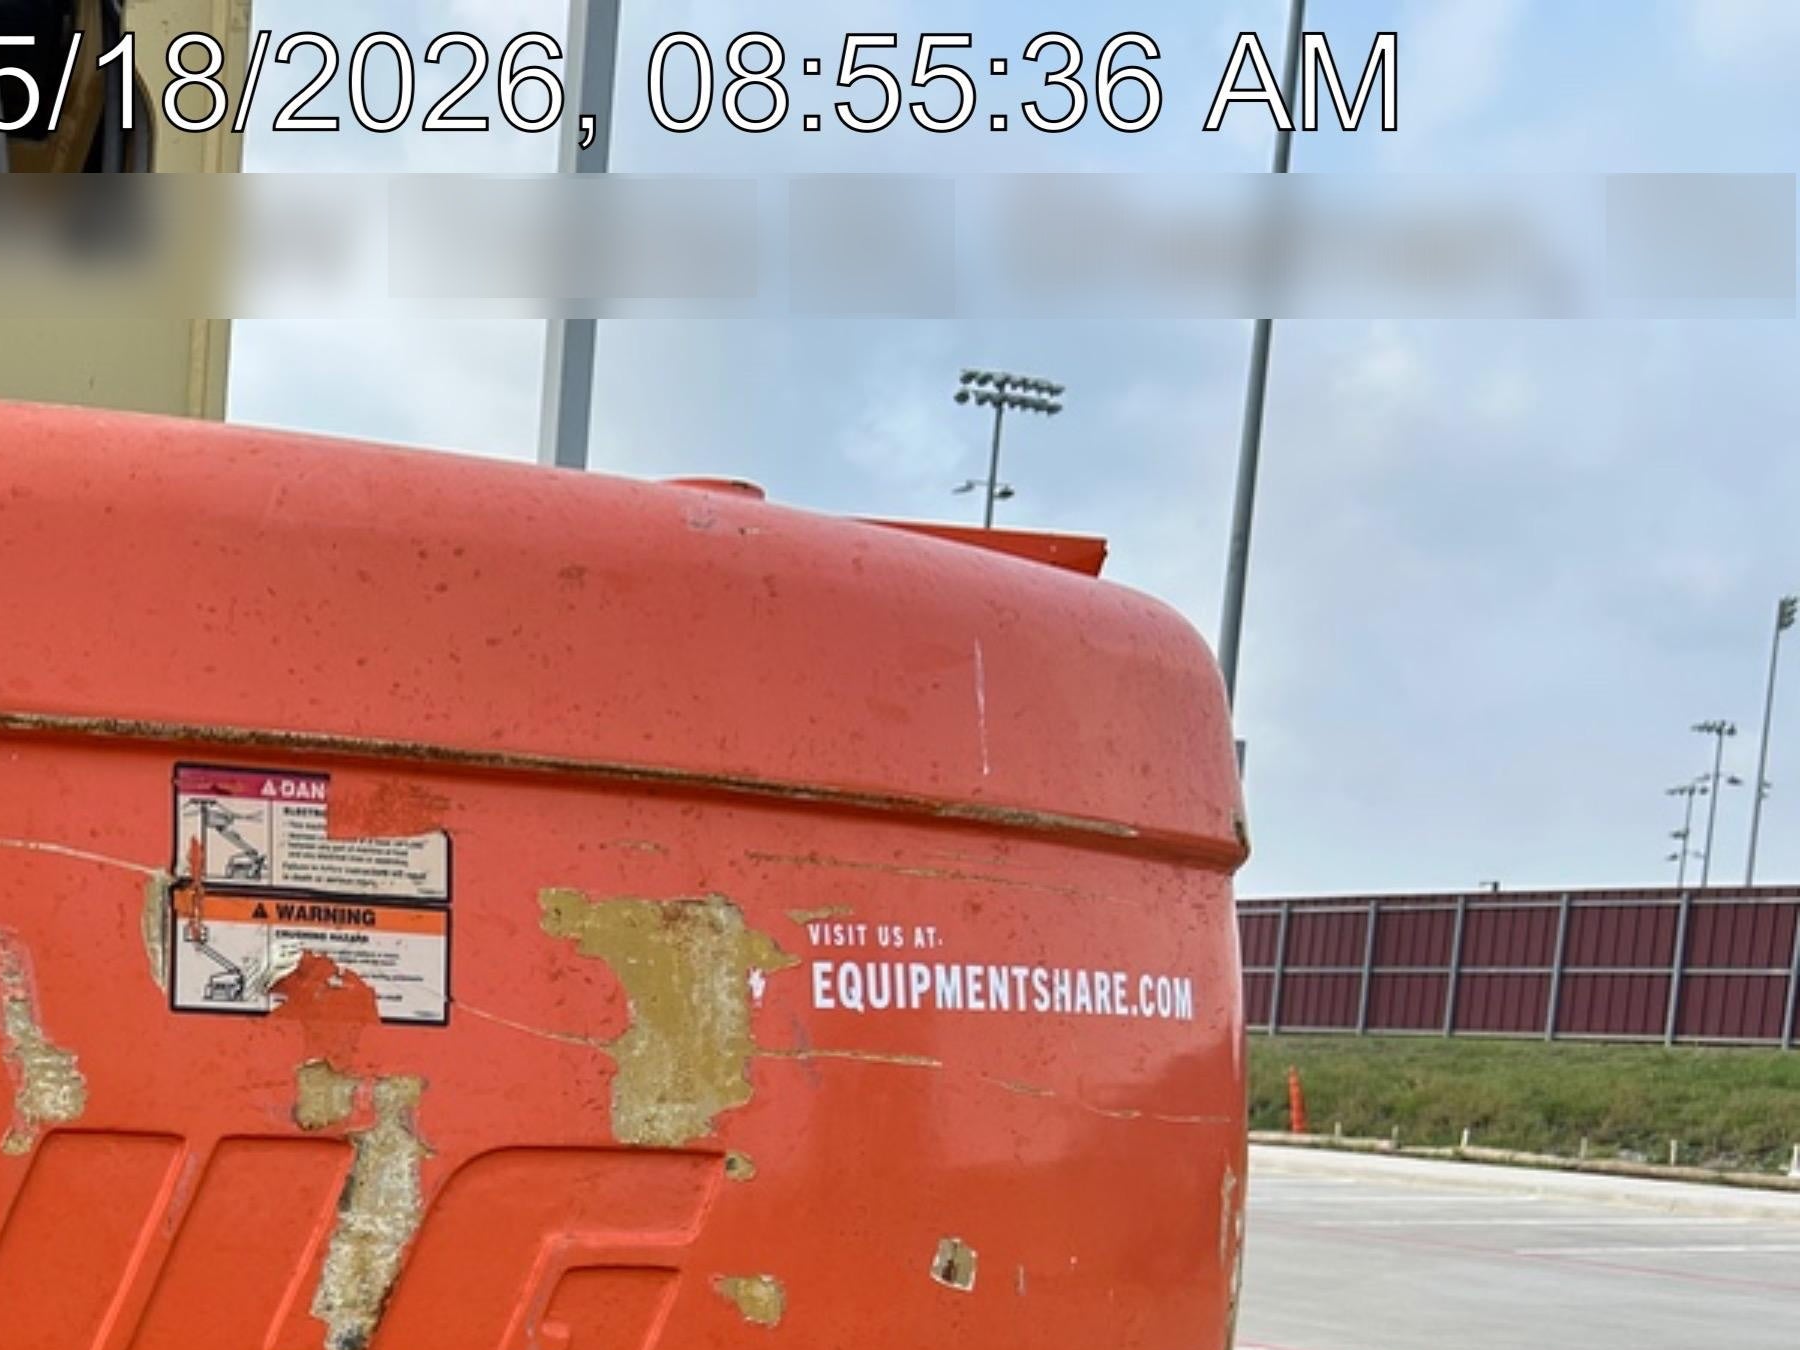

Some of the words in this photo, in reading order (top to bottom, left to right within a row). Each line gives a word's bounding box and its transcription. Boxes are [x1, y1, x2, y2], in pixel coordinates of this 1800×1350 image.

[276, 903, 376, 926] WARNING
[808, 924, 867, 947] VISIT
[878, 926, 904, 948] US
[813, 962, 1194, 1021] EQUIPMENTSHARE.COM
